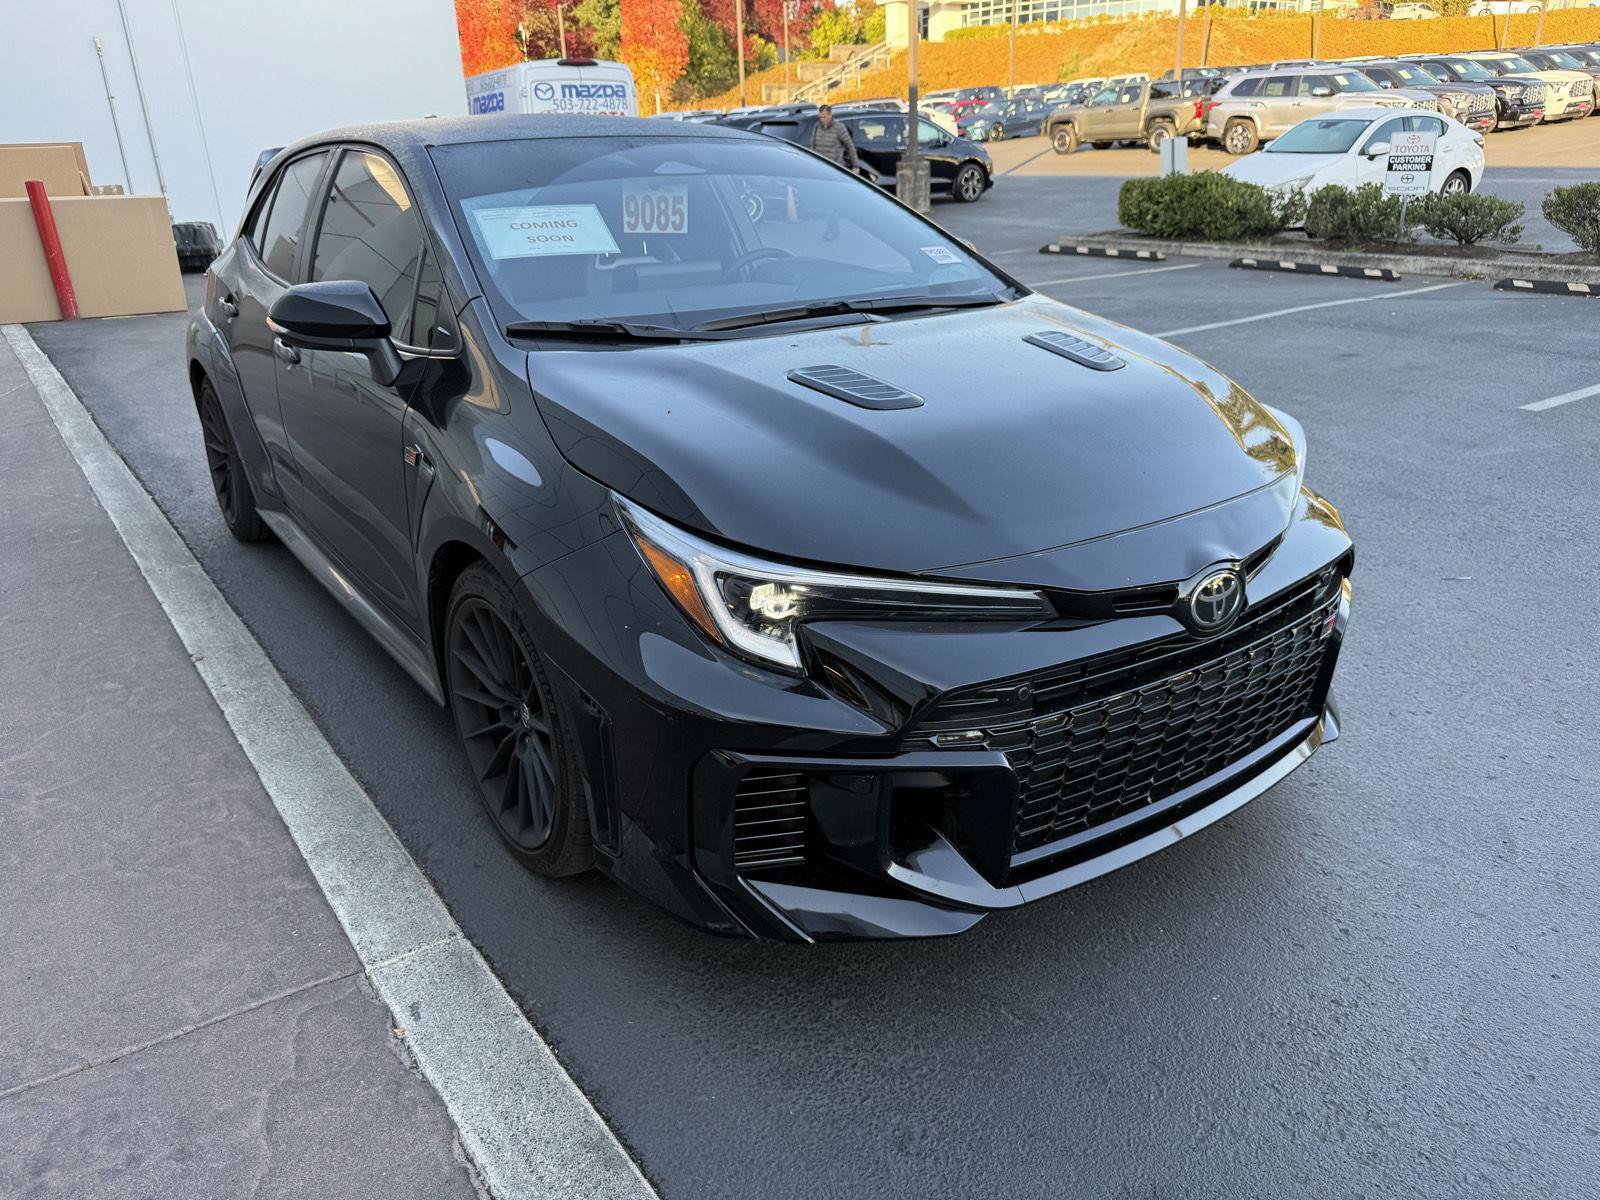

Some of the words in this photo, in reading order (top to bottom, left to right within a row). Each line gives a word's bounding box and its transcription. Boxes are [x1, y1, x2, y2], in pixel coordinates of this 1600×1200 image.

[552, 99, 628, 110] 503-722-4878
[1395, 145, 1430, 153] TOYOTA
[1389, 156, 1431, 164] CUSTOMER
[1392, 163, 1427, 171] PARKING
[625, 194, 685, 232] 9085
[509, 219, 579, 230] COMING
[526, 234, 575, 243] SOON
